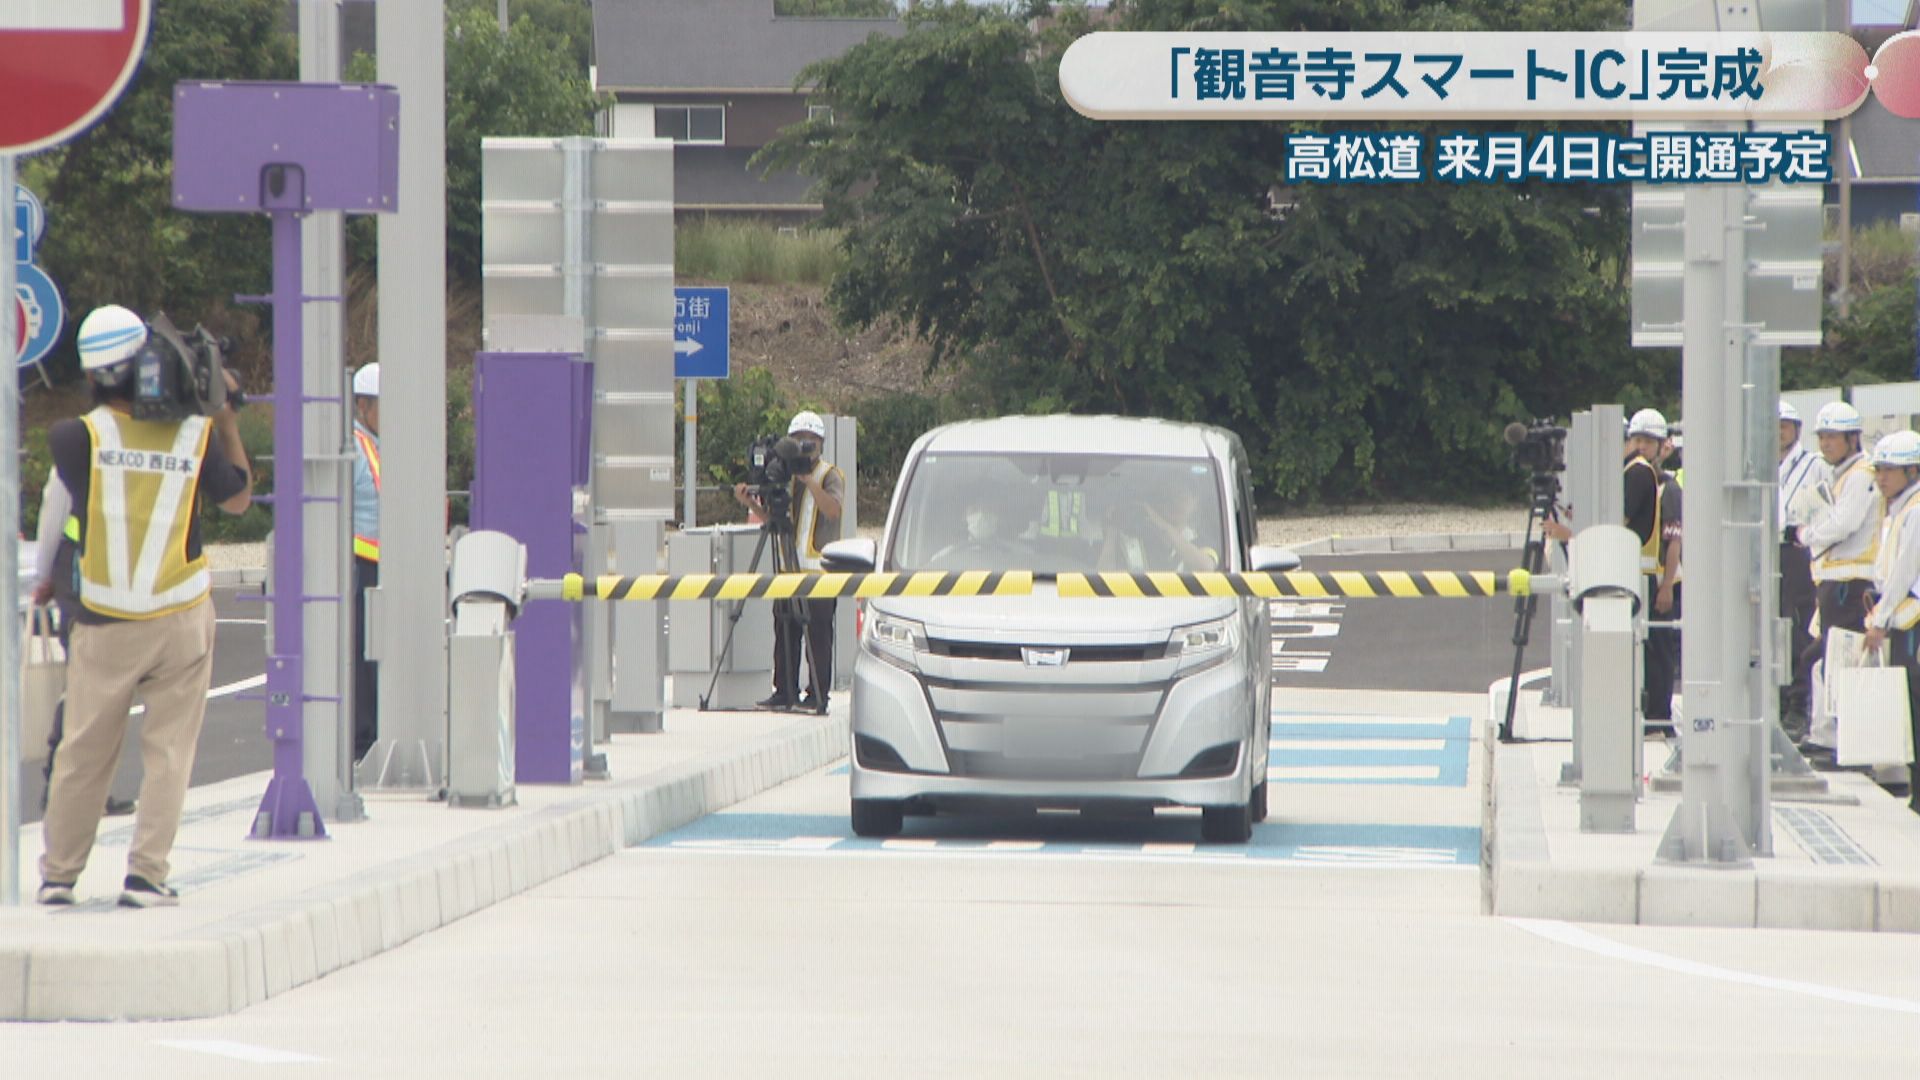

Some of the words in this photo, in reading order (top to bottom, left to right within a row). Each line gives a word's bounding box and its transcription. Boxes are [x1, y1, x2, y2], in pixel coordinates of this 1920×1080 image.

[675, 320, 701, 335] onji
[99, 450, 144, 467] NEXCO
[149, 454, 193, 473] 西日本
